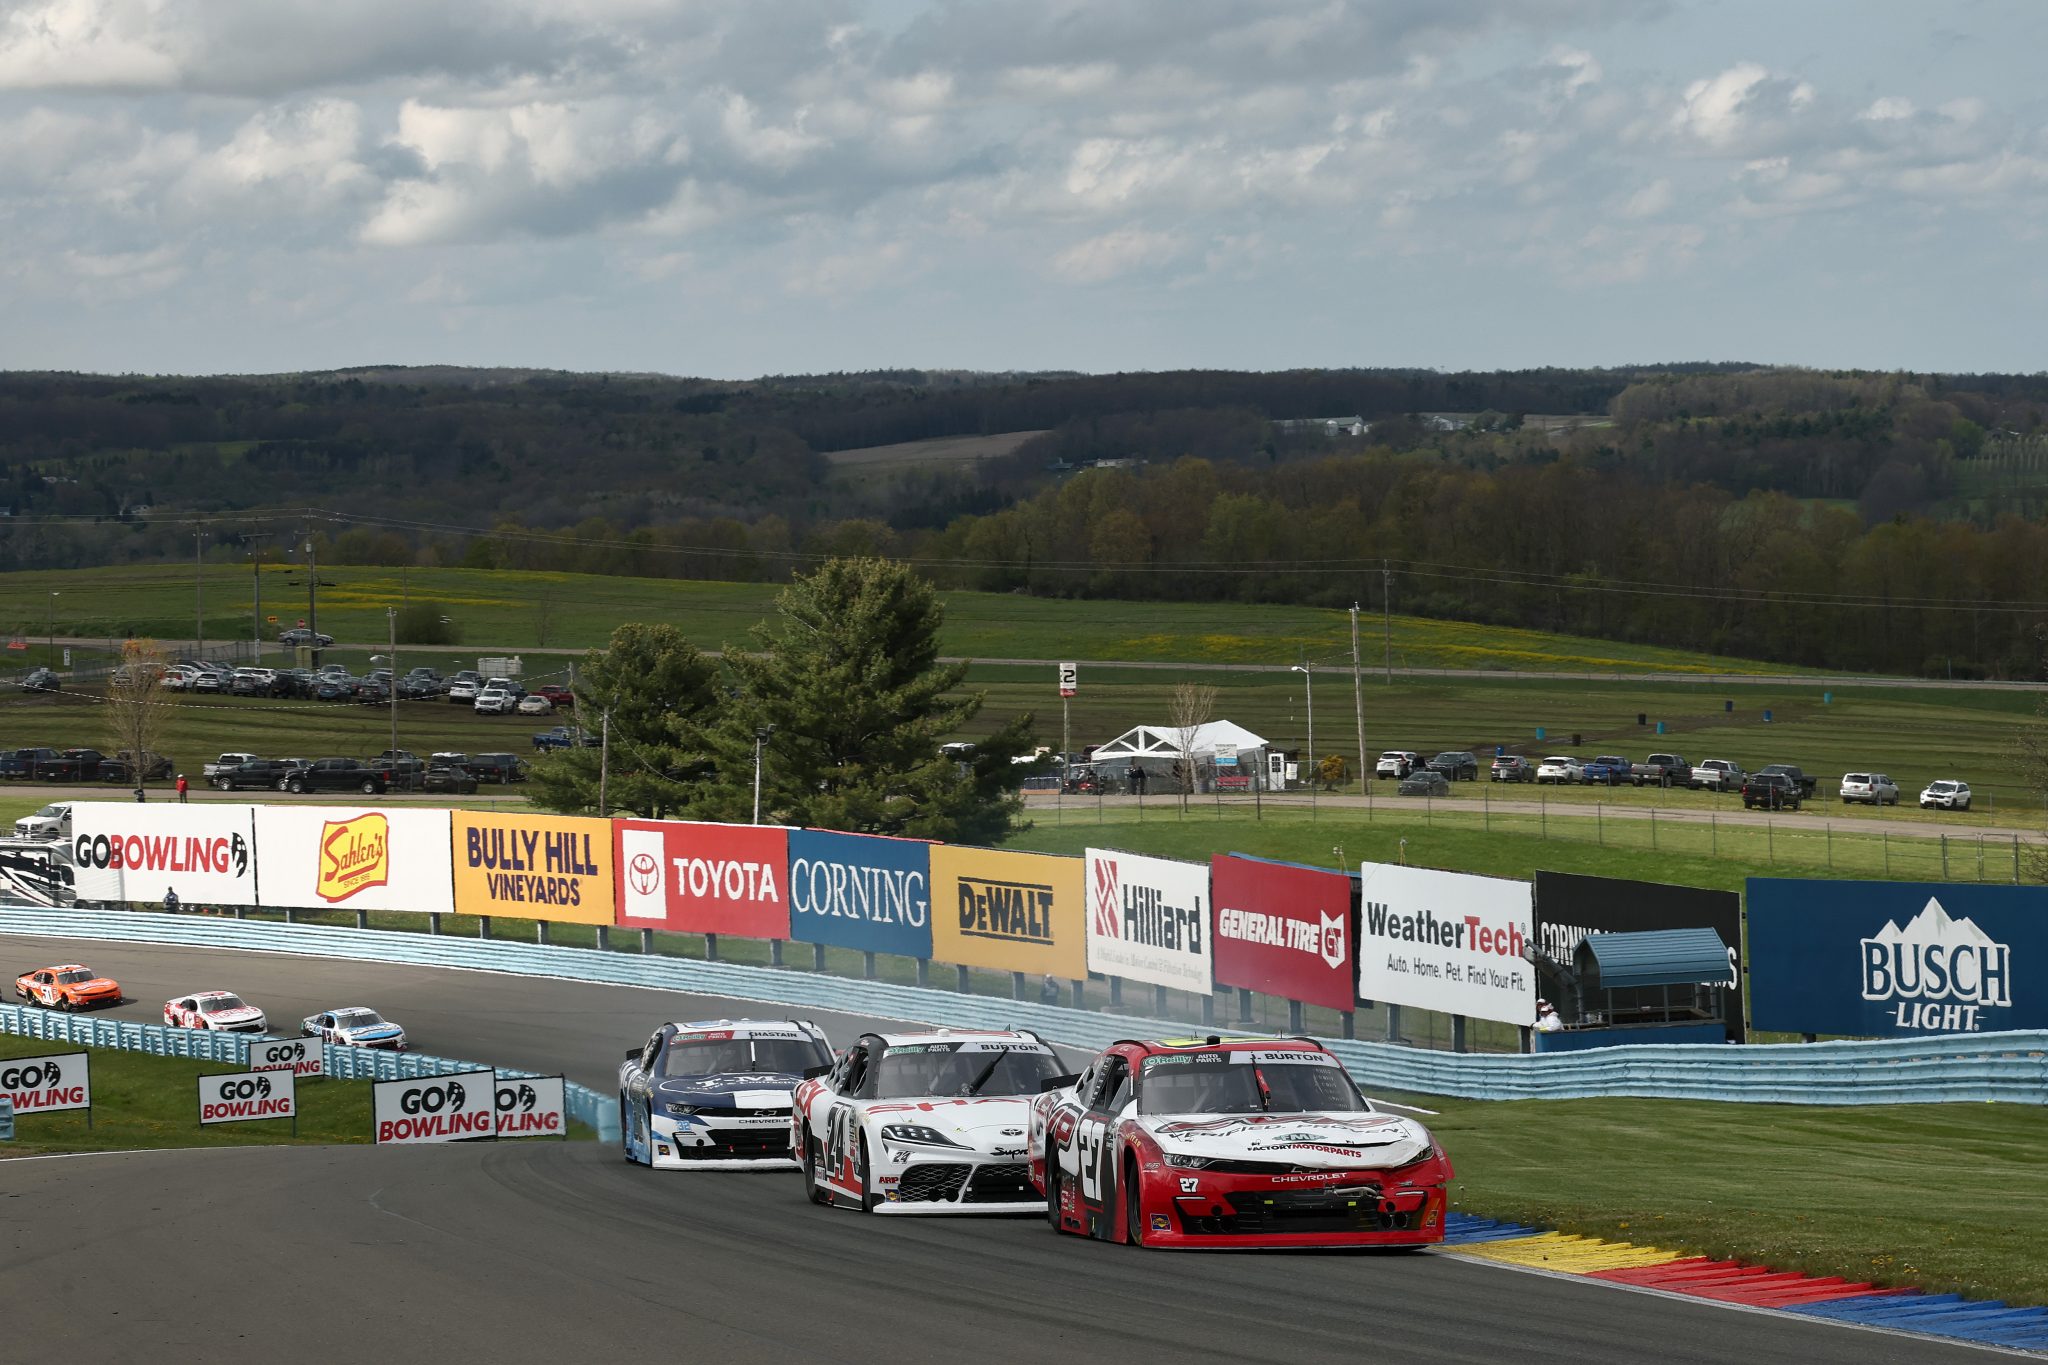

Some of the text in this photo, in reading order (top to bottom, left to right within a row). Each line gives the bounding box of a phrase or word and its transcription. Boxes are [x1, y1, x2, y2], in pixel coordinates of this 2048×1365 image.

[1063, 669, 1075, 683] 2
[324, 826, 383, 881] Sahlen's
[467, 827, 598, 876] BULLY HILL
[486, 872, 580, 906] VINEYARDS
[673, 857, 779, 902] TOYOTA
[792, 858, 927, 927] CORNING
[1123, 883, 1202, 955] Hilliard
[1219, 908, 1320, 954] GENERAL TIRE
[1367, 902, 1524, 958] WeatherTech
[1541, 921, 1601, 967] CORN
[1387, 953, 1526, 992] Auto. Home. Pet. Find Your Fit.
[1862, 940, 2011, 1006] BUSCH
[1896, 1001, 1979, 1030] LIGHT
[266, 1044, 293, 1062] GO
[981, 1043, 1039, 1051] BURTON
[1266, 1053, 1324, 1061] BURTON
[2, 1066, 42, 1089] GO
[220, 1080, 255, 1100] GO
[0, 1087, 83, 1109] WLING
[203, 1098, 290, 1119] BOWLING
[401, 1086, 445, 1114] GO
[496, 1088, 517, 1111] O
[379, 1111, 490, 1142] BOWLING
[676, 1121, 691, 1131] 32
[827, 1103, 849, 1181] 24
[990, 1146, 1028, 1160] Supr
[893, 1151, 911, 1163] 24
[1080, 1118, 1105, 1201] 27
[1180, 1177, 1199, 1193] 27
[1271, 1172, 1347, 1183] CHEVROLET
